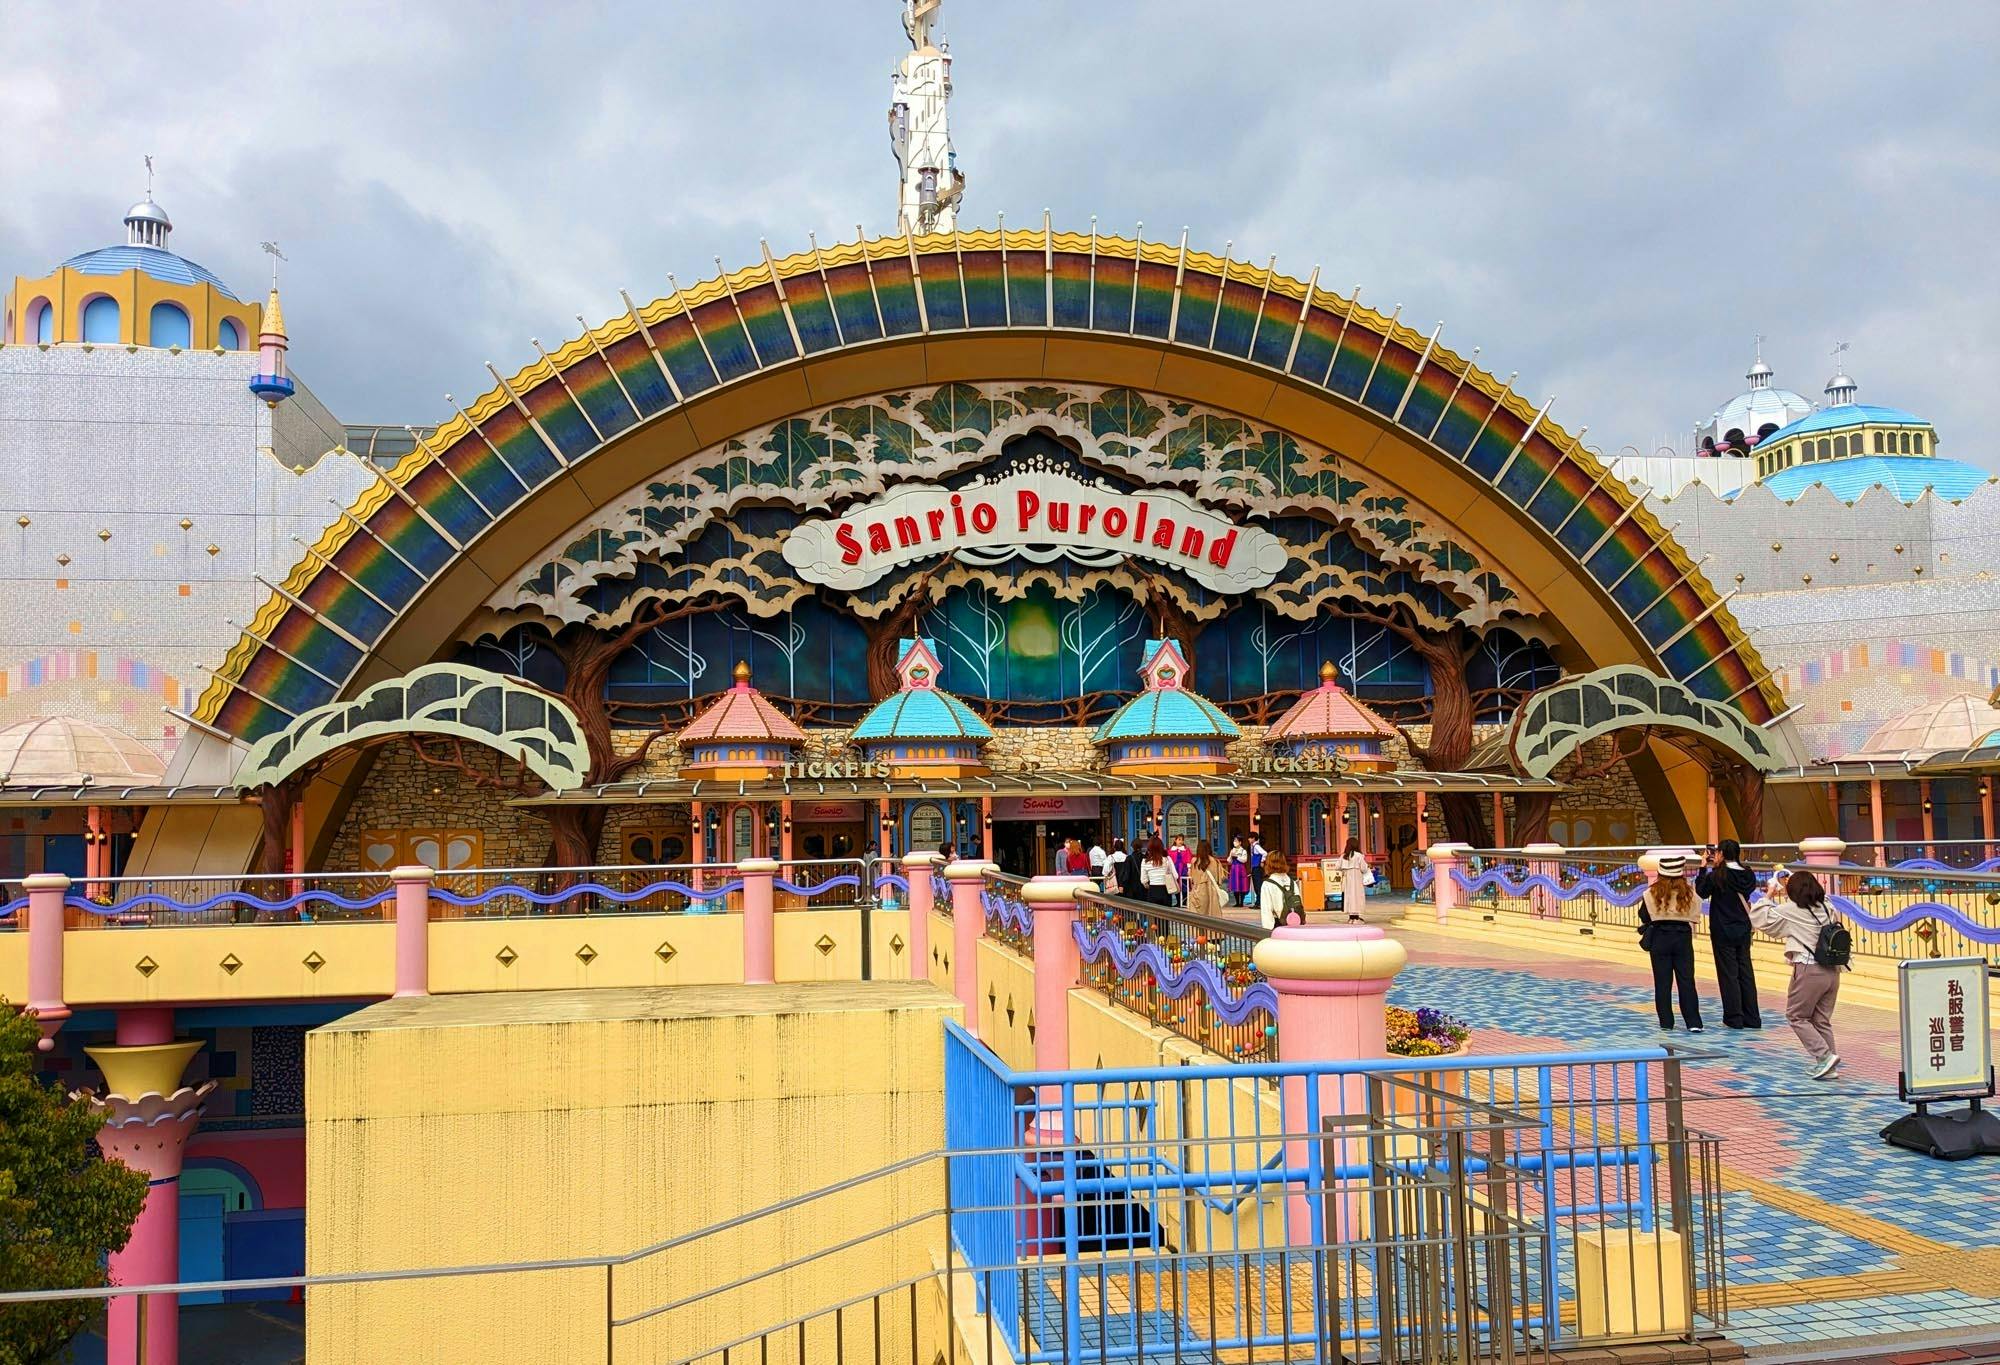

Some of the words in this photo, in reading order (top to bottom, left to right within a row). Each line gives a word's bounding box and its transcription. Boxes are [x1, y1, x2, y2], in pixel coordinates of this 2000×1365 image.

[835, 494, 998, 565] Sanrio
[1017, 489, 1239, 569] Puroland
[781, 761, 890, 778] TICKETS
[1248, 756, 1350, 773] TICKETS
[1023, 797, 1064, 809] Sanrio
[1948, 979, 1964, 1051] 私服警官
[1929, 1016, 1945, 1071] 巡回中
